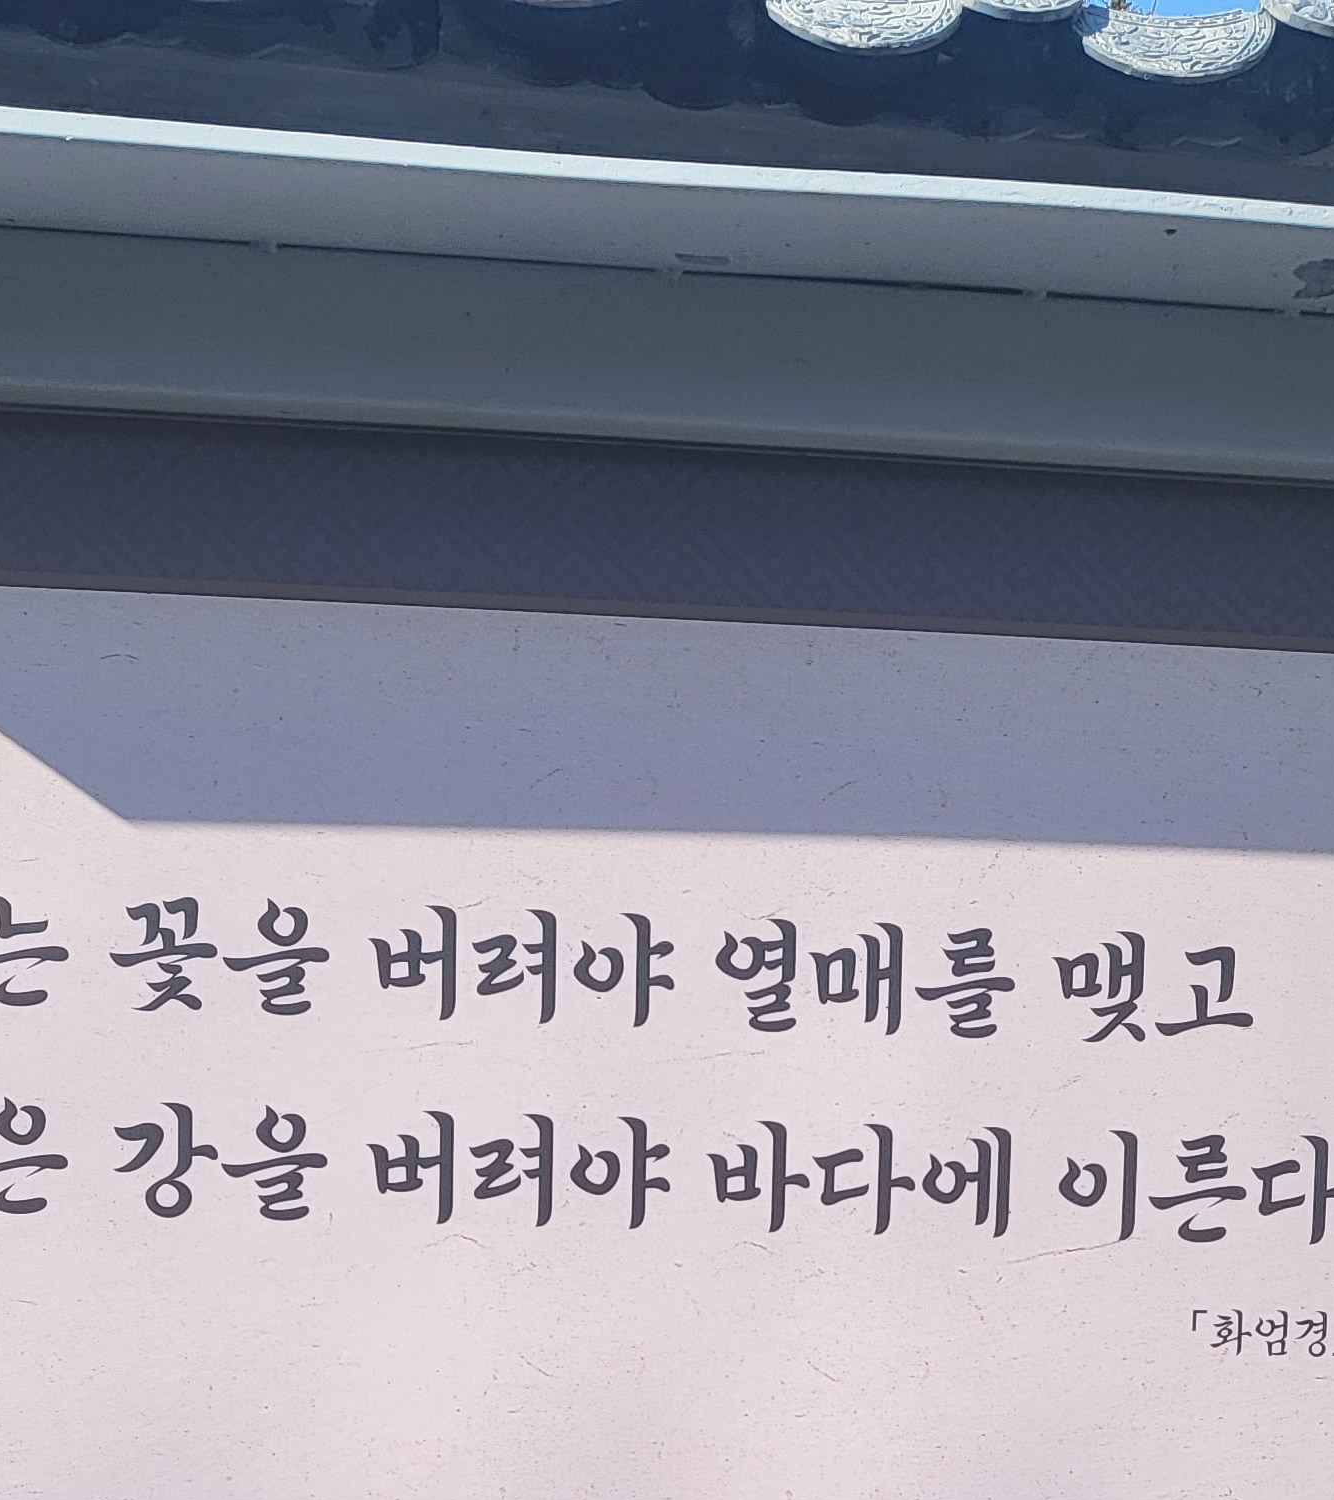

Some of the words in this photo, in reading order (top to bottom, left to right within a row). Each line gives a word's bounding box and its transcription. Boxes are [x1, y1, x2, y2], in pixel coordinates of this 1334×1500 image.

[107, 895, 331, 1017] 꽃을
[367, 903, 676, 1029] 버려야
[713, 917, 1017, 1040] 열매를
[1050, 929, 1255, 1044] 맺고
[112, 1101, 329, 1223] 강을
[364, 1109, 672, 1231] 버려야
[705, 1119, 1013, 1240] 바다에
